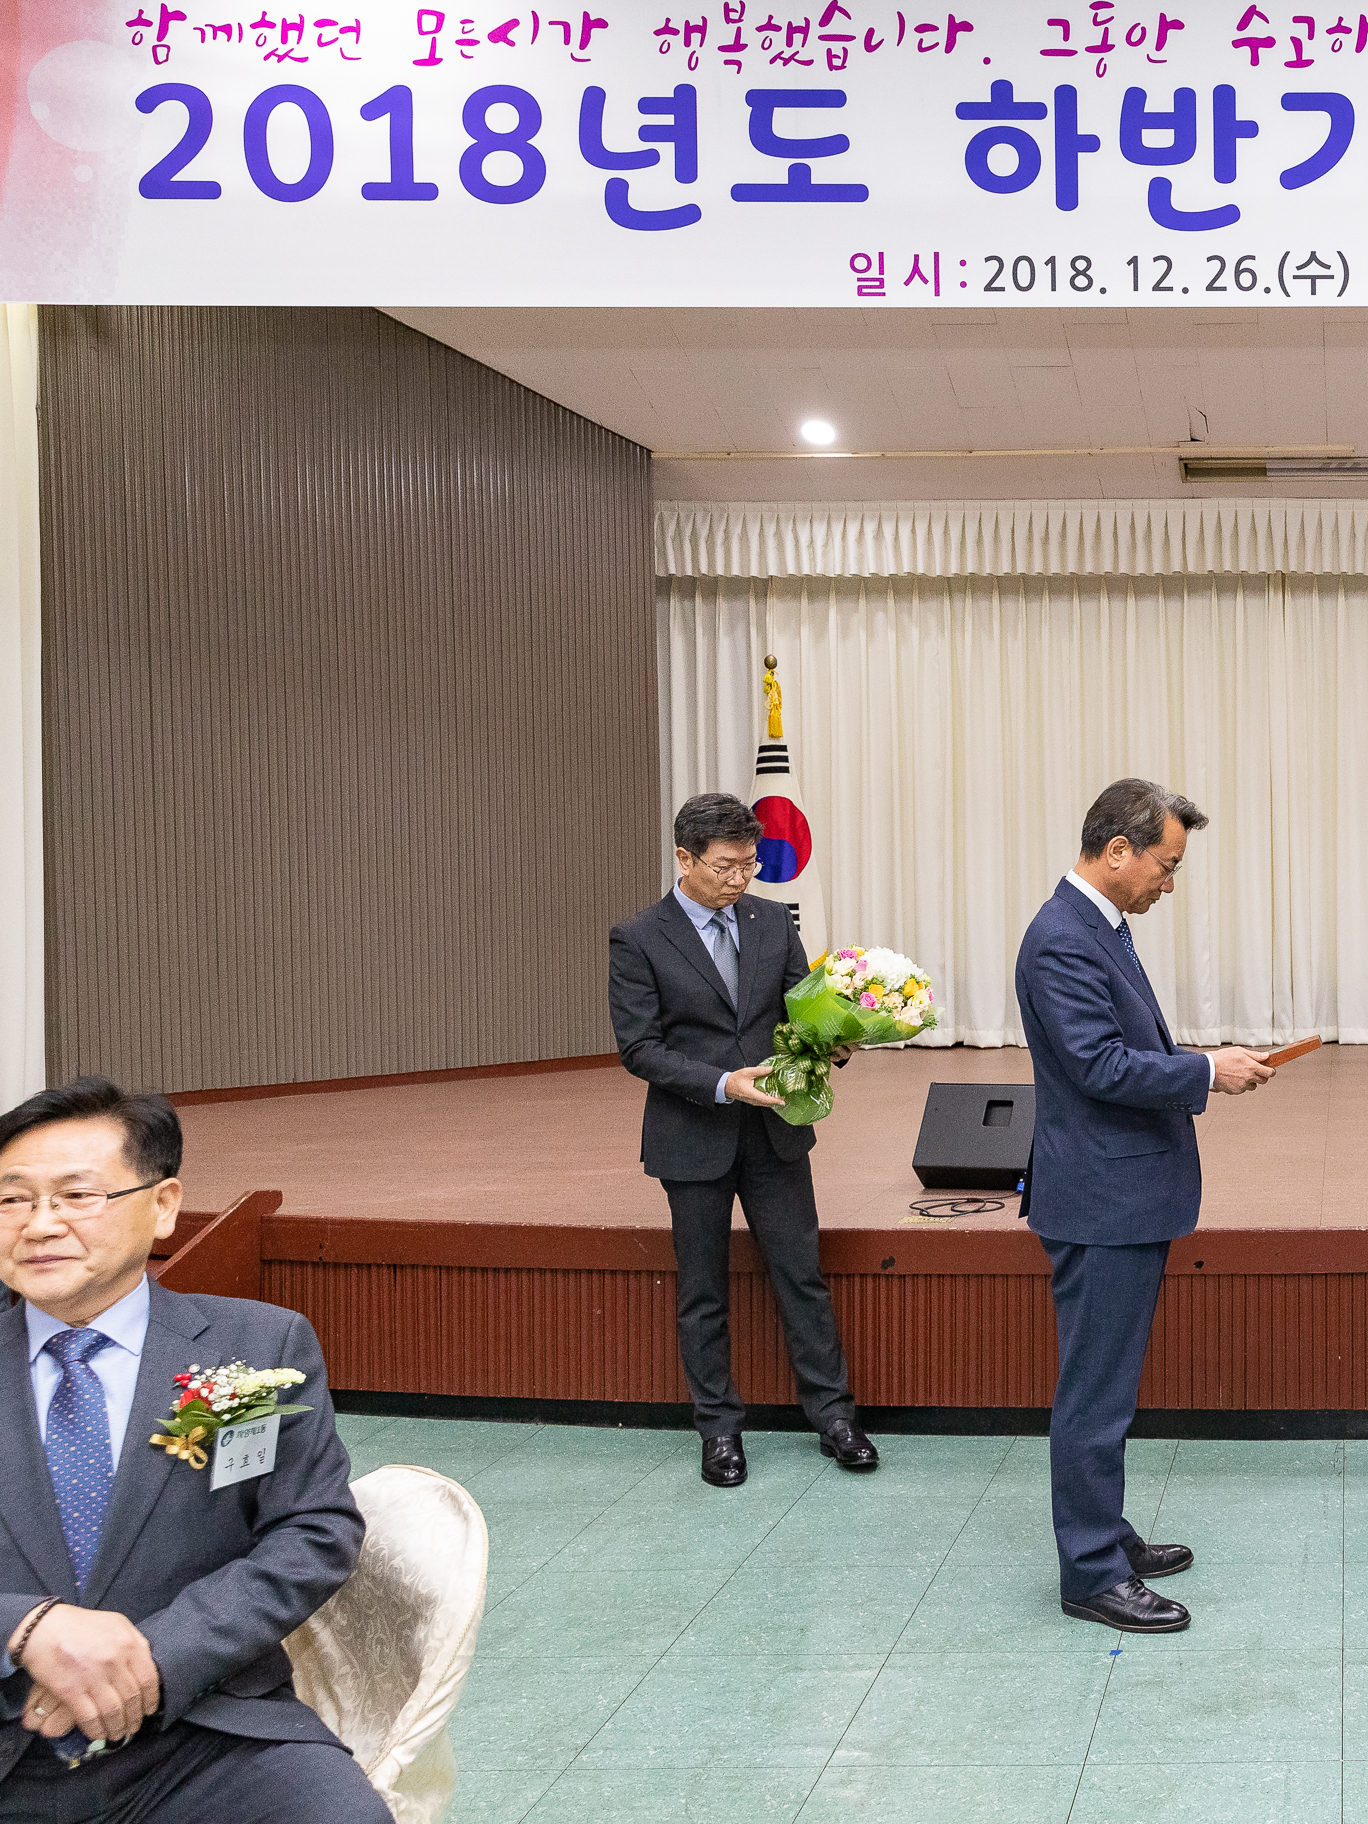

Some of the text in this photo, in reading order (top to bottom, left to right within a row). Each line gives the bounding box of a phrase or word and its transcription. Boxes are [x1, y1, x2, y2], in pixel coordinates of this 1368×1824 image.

[125, 3, 361, 66] 함께했던
[654, 0, 992, 75] 행복했습니다.
[1039, 1, 1186, 78] 그동안
[135, 82, 870, 232] 2018년도
